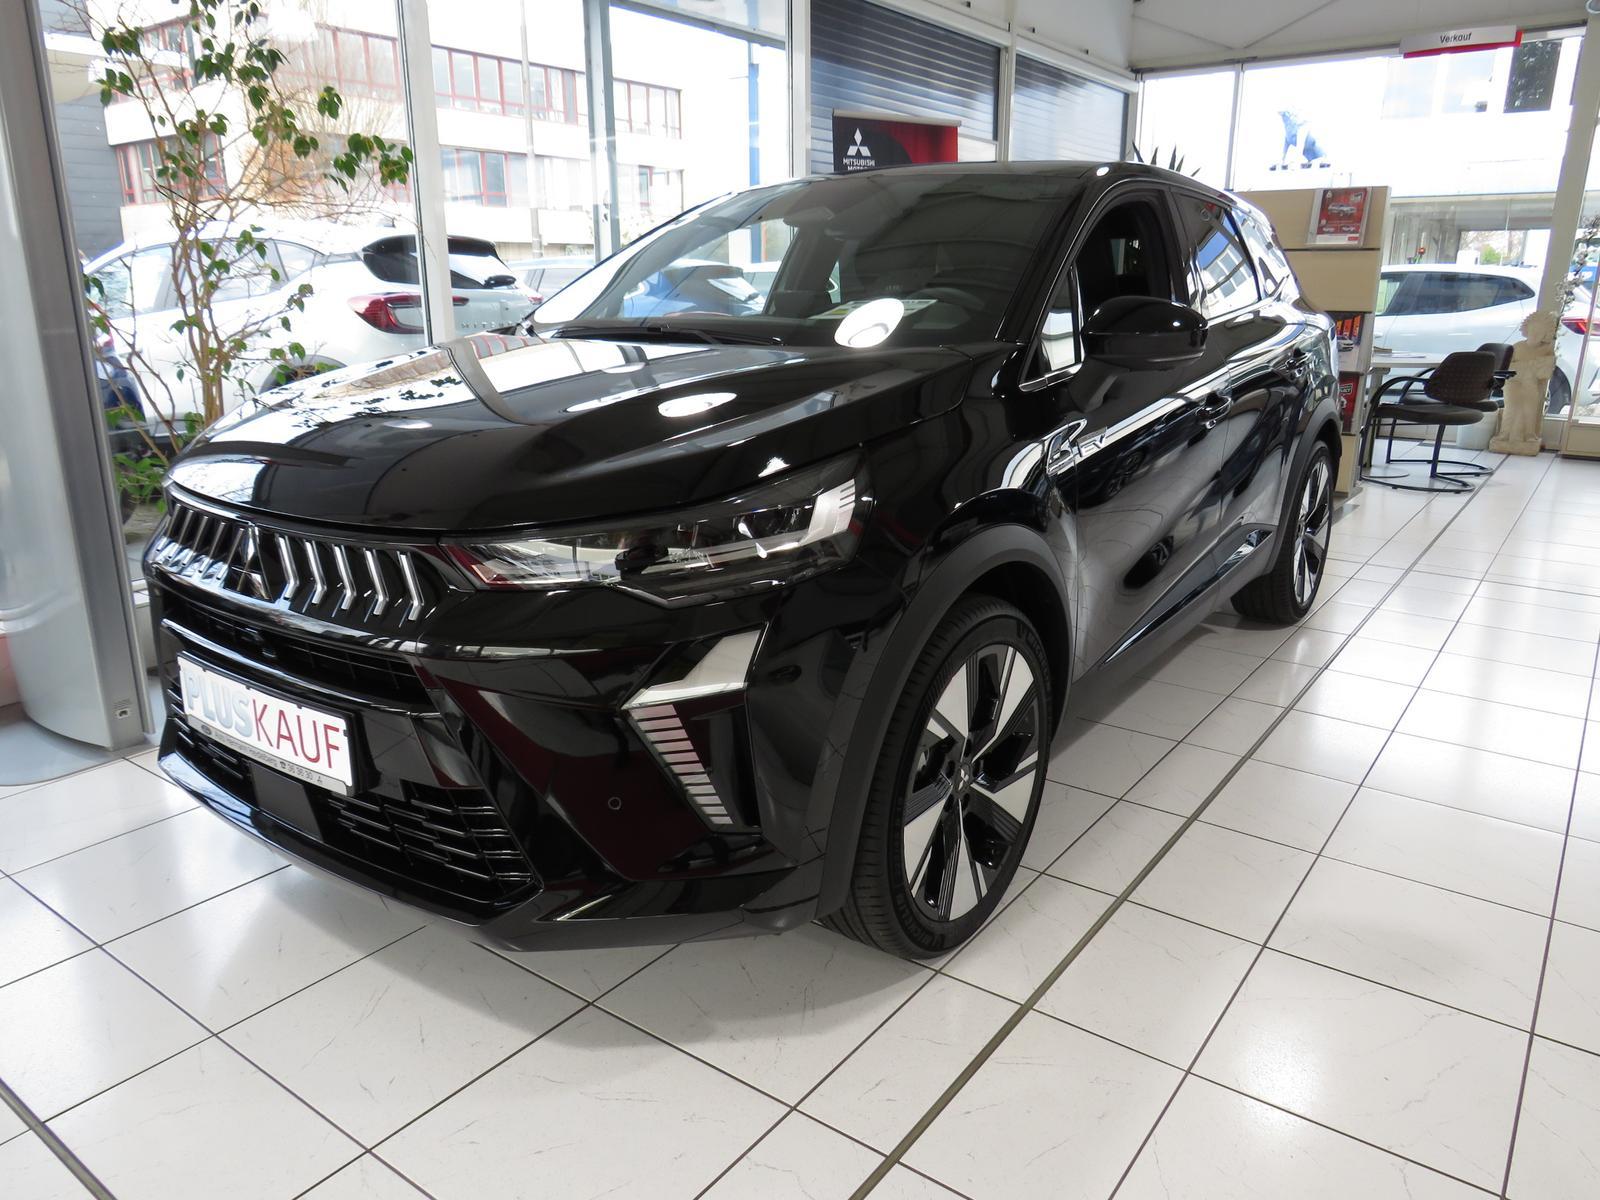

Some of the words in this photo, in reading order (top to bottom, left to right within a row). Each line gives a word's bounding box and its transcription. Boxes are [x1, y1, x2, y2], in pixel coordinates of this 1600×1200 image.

[1440, 31, 1472, 44] Verkauf
[842, 157, 876, 167] MITSUBISHI
[184, 670, 340, 769] PLUSKAUF
